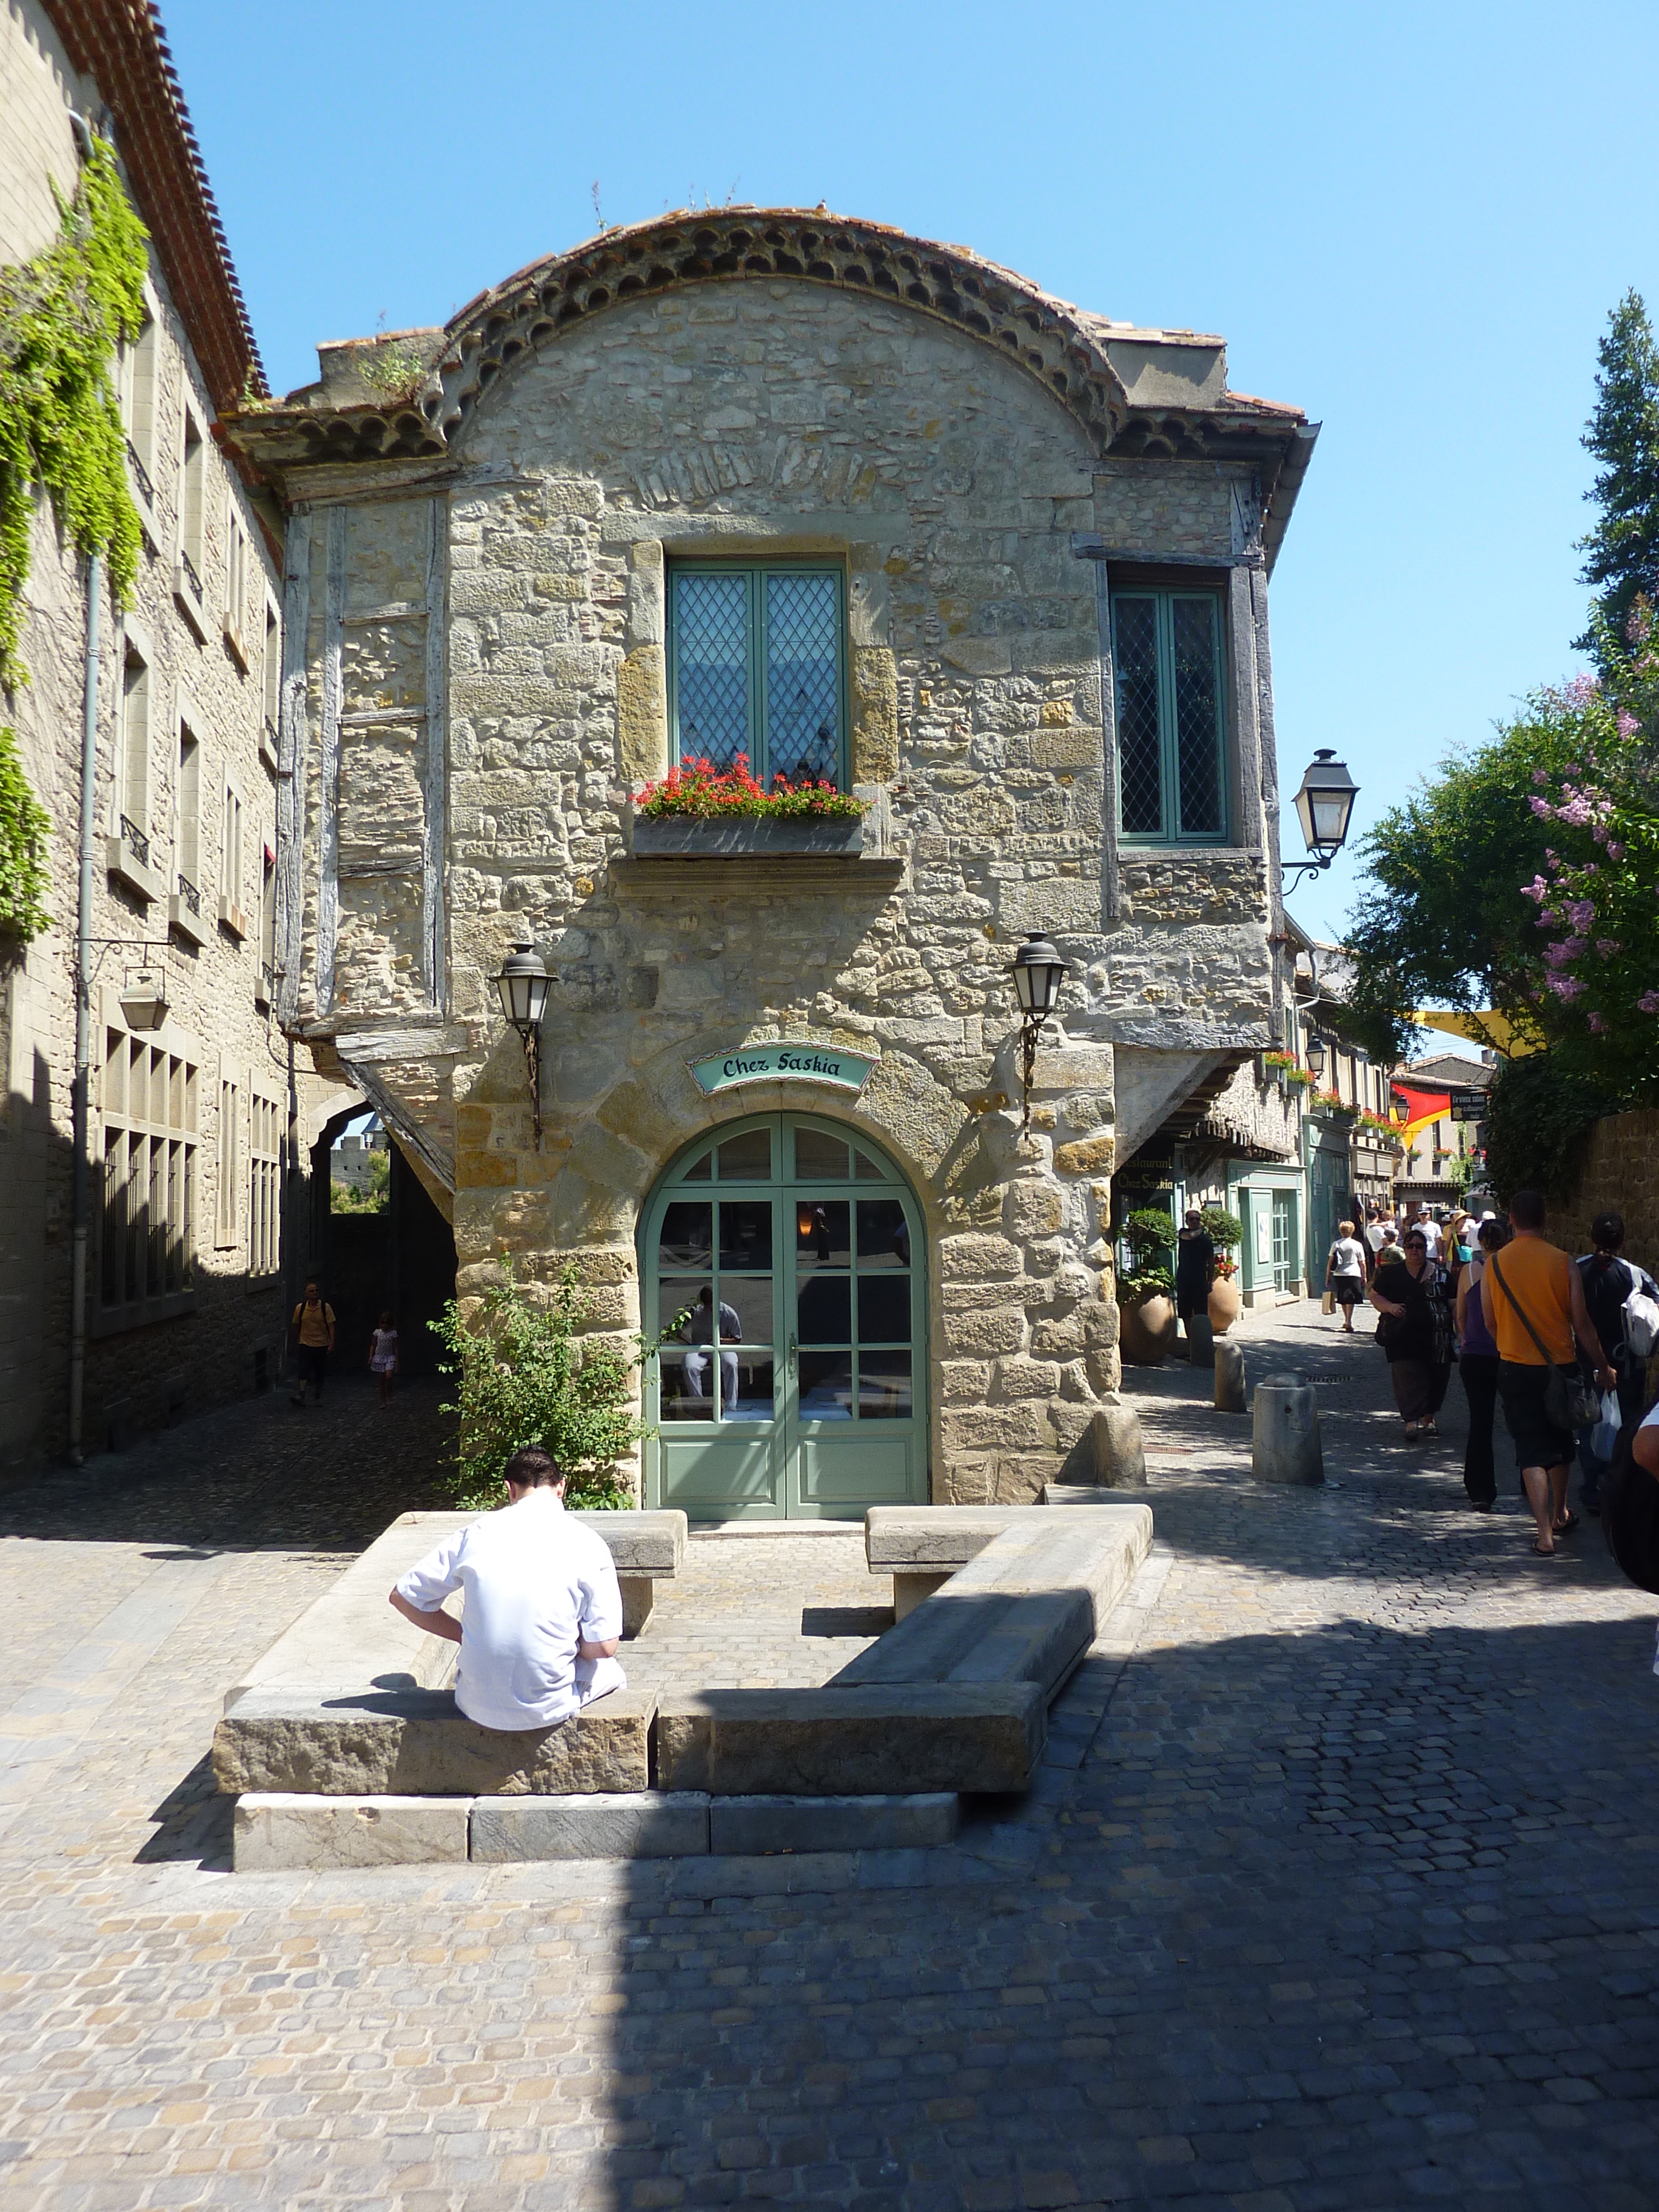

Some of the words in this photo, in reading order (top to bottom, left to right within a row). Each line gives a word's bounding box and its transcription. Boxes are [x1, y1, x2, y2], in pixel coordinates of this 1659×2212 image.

[723, 1057, 769, 1078] Chez
[777, 1052, 840, 1076] Saskia
[1117, 1173, 1141, 1188] Chez
[1141, 1173, 1173, 1190] Saskia
